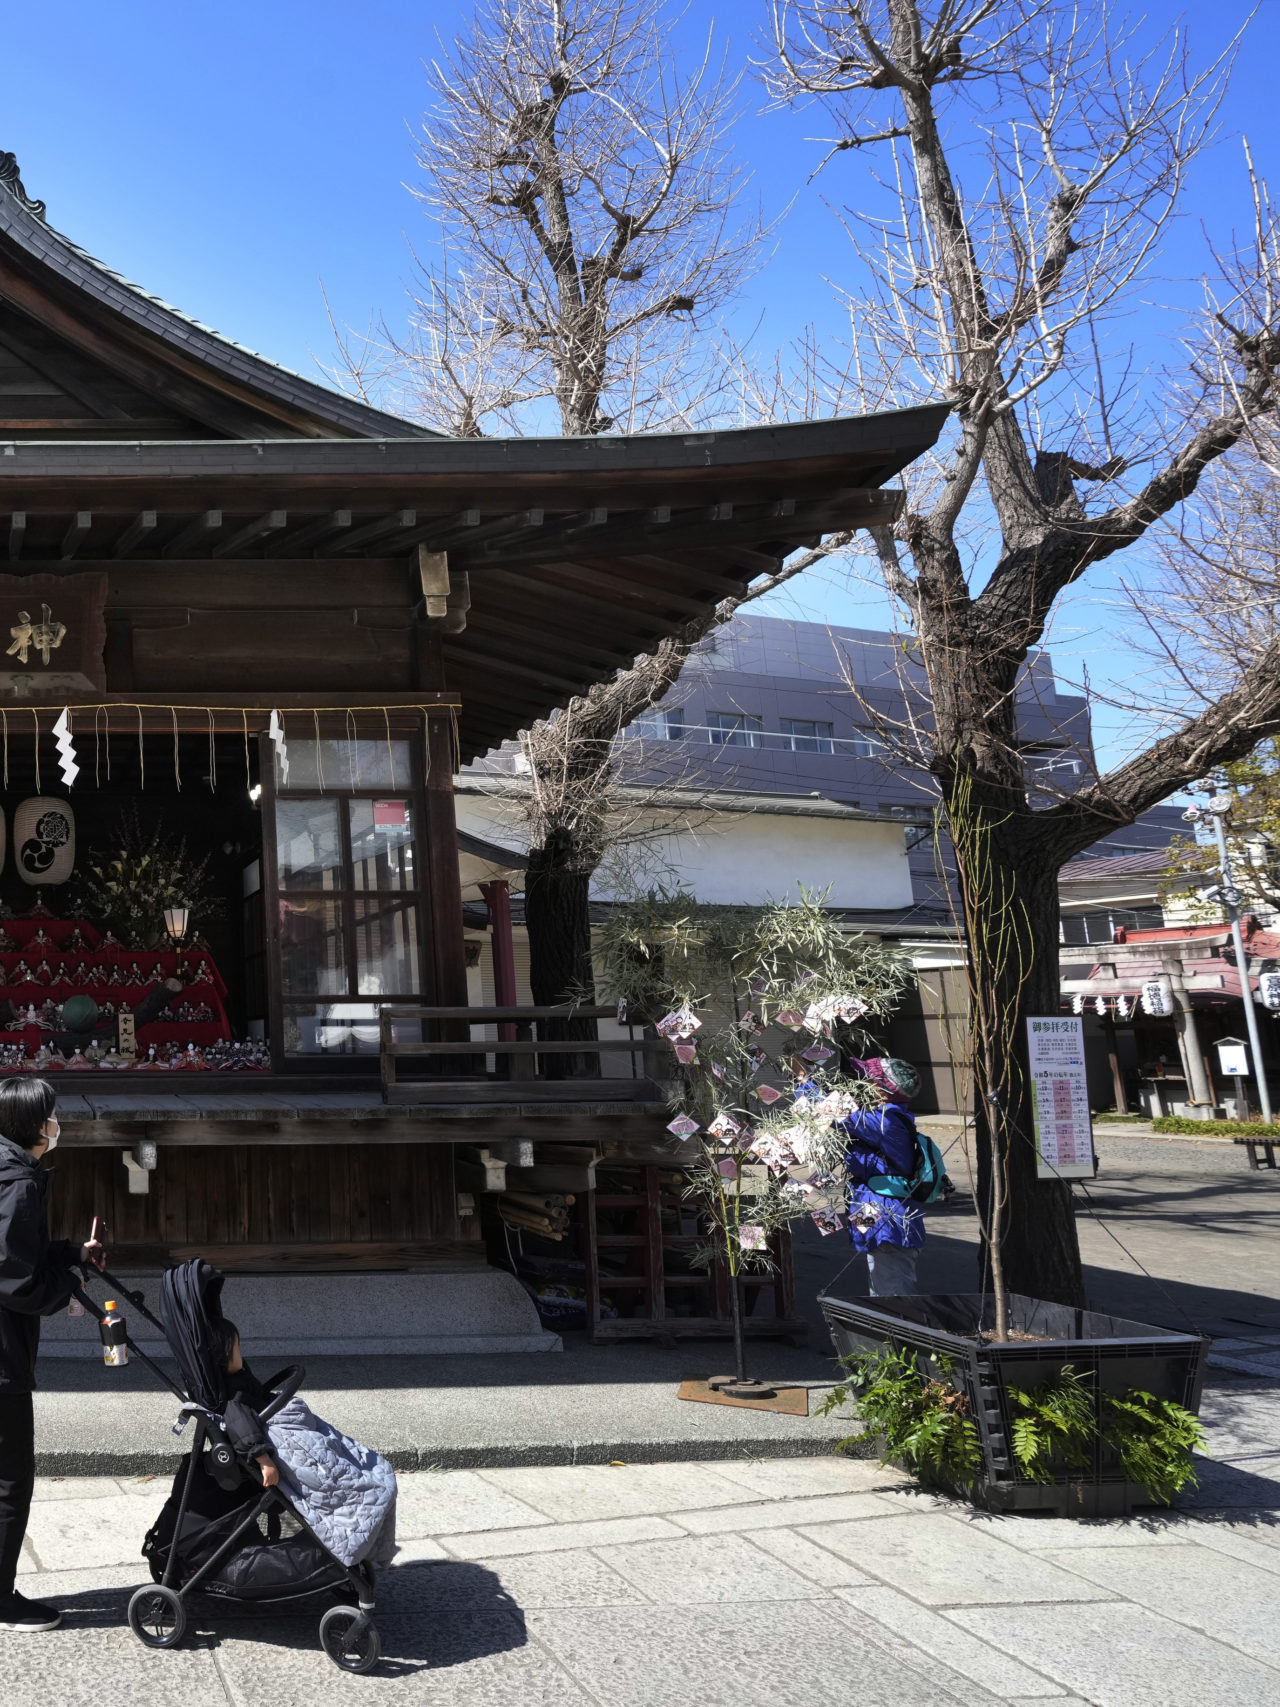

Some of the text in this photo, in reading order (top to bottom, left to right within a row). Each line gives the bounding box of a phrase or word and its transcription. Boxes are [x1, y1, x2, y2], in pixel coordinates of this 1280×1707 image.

[1032, 1021, 1078, 1033] 御参拝受付
